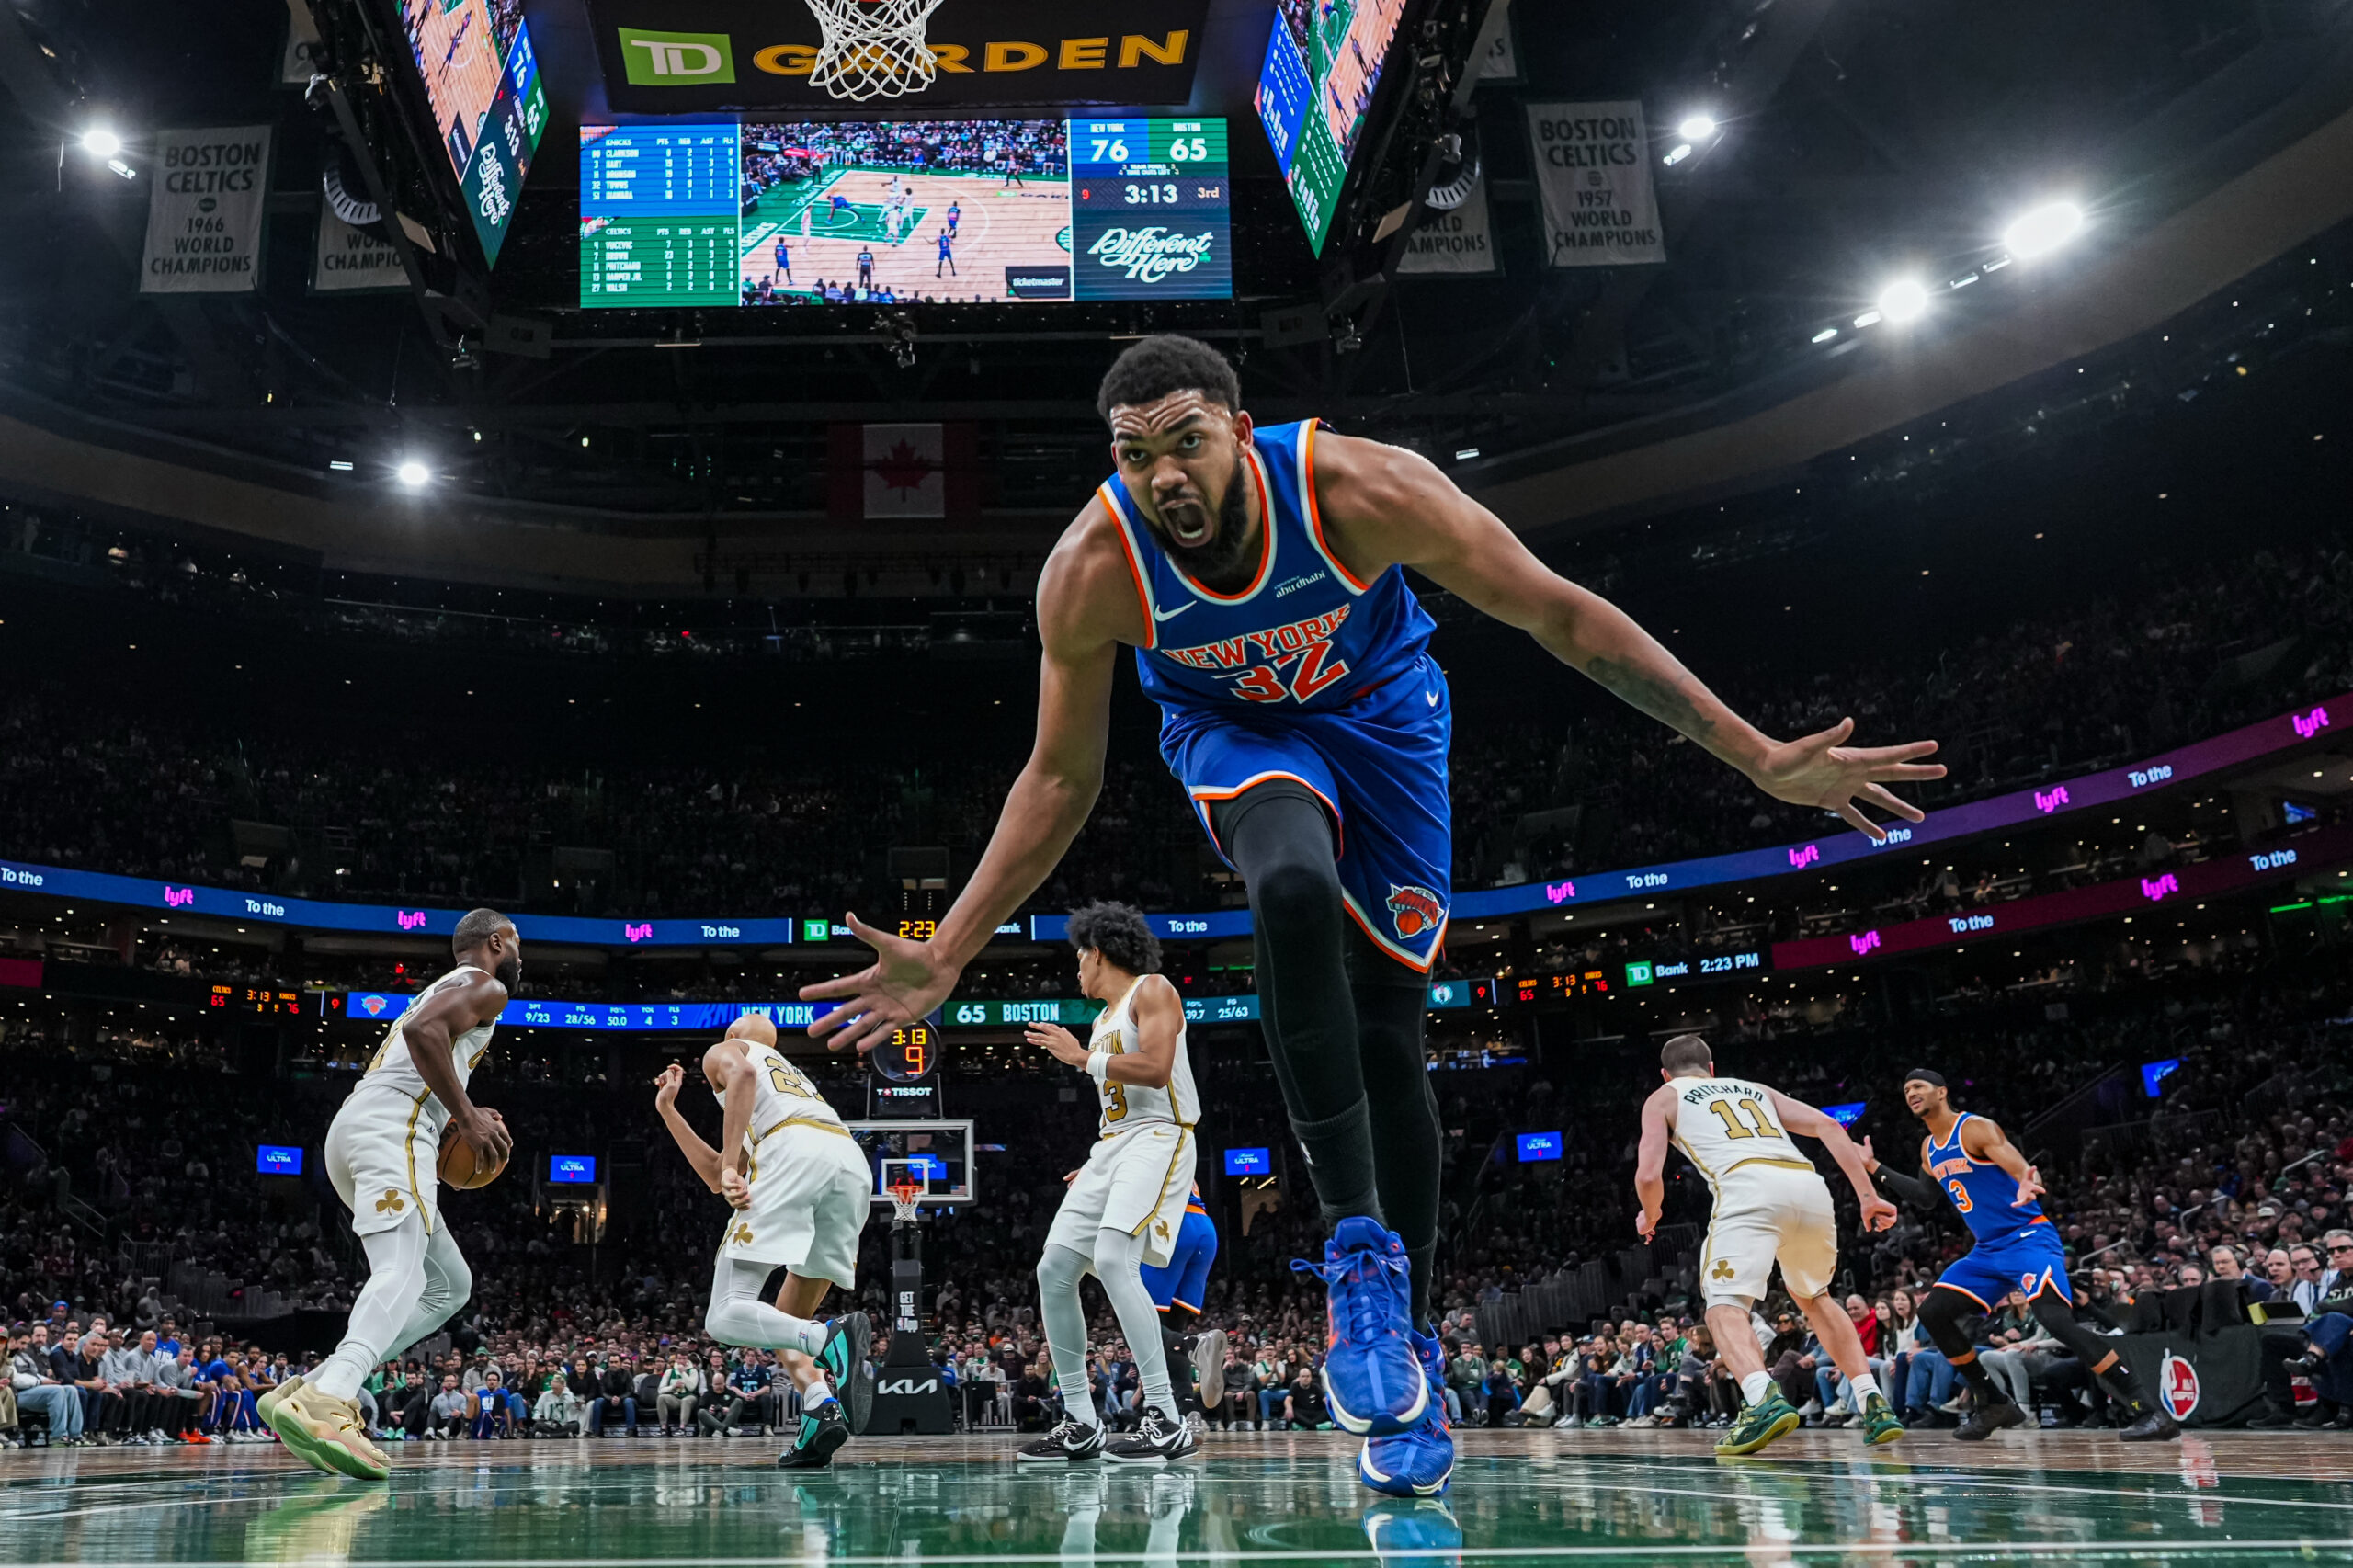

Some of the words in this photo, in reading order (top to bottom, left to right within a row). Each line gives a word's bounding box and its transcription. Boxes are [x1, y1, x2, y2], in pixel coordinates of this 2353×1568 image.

[630, 39, 722, 75] TD
[753, 30, 1189, 75] GARDEN
[1539, 118, 1636, 141] BOSTON
[165, 142, 260, 167] BOSTON
[1091, 139, 1129, 162] 76
[1169, 138, 1207, 161] 65
[1548, 143, 1637, 167] CELTICS
[166, 169, 253, 194] CELTICS
[1082, 188, 1090, 199] 9
[1125, 184, 1178, 204] 3:13
[1198, 187, 1219, 198] 3rd
[1577, 190, 1612, 208] 1957
[187, 216, 224, 233] 1966
[1572, 210, 1632, 228] WORLD
[174, 237, 233, 254] WORLD
[1087, 227, 1213, 256] Different
[1408, 234, 1485, 254] AMPIONS
[1554, 229, 1656, 248] CHAMPIONS
[151, 256, 251, 274] CHAMPIONS
[324, 252, 402, 271] CHAMPIO
[1102, 251, 1199, 283] Here
[1013, 278, 1064, 287] ticketmaster
[1276, 585, 1296, 598] abu
[1296, 570, 1325, 589] dhabi
[1161, 635, 1247, 669] NEW
[1248, 603, 1351, 659] YORK
[1211, 640, 1351, 704] 32
[2292, 707, 2329, 738] lyft
[2128, 771, 2148, 787] To
[2149, 766, 2172, 782] the
[2035, 787, 2069, 812] lyft
[1887, 828, 1912, 845] the
[1789, 845, 1819, 869] lyft
[2250, 856, 2270, 870] To
[2271, 850, 2296, 867] the
[1, 868, 17, 881] To
[19, 871, 43, 885] the
[1626, 876, 1643, 888] To
[1644, 873, 1667, 886] the
[165, 886, 193, 906] lyft
[1547, 882, 1575, 903] lyft
[2142, 874, 2178, 901] lyft
[246, 900, 260, 913] To
[263, 903, 284, 916] the
[398, 911, 426, 929] lyft
[899, 920, 936, 938] 2:23
[1168, 921, 1184, 932] To
[1186, 921, 1207, 932] the
[1949, 918, 1969, 932] To
[1970, 915, 1993, 930] the
[626, 924, 652, 942] lyft
[701, 926, 716, 937] To
[718, 926, 740, 937] the
[808, 924, 825, 937] TD
[1850, 931, 1881, 955] lyft
[1629, 966, 1650, 982] TD
[1655, 961, 1688, 977] Bank
[1700, 956, 1733, 973] 2:23
[1734, 953, 1759, 969] PM
[1552, 974, 1576, 988] 3:13
[210, 995, 225, 1006] 65
[246, 989, 270, 1002] 3:13
[1477, 986, 1485, 998] 9
[1520, 989, 1534, 1001] 65
[332, 999, 340, 1009] 9
[956, 1005, 986, 1024] 65
[1002, 1003, 1060, 1023] BOSTON
[1186, 1009, 1205, 1019] 39.7
[1218, 1006, 1248, 1018] 25/63
[525, 1012, 550, 1023] 9/23
[565, 1014, 596, 1025] 28/56
[607, 1017, 627, 1027] 50.0
[645, 1016, 653, 1026] 4
[671, 1016, 678, 1025] 3
[776, 1006, 814, 1025] YORK
[892, 1029, 926, 1045] 3:13
[905, 1046, 923, 1074] 9
[892, 1087, 933, 1096] TISSOT
[1684, 1085, 1764, 1105] PRITCHARD
[1709, 1098, 1783, 1140] 11
[1949, 1179, 1973, 1213] 3
[900, 1291, 915, 1303] GET
[900, 1304, 915, 1316] THE
